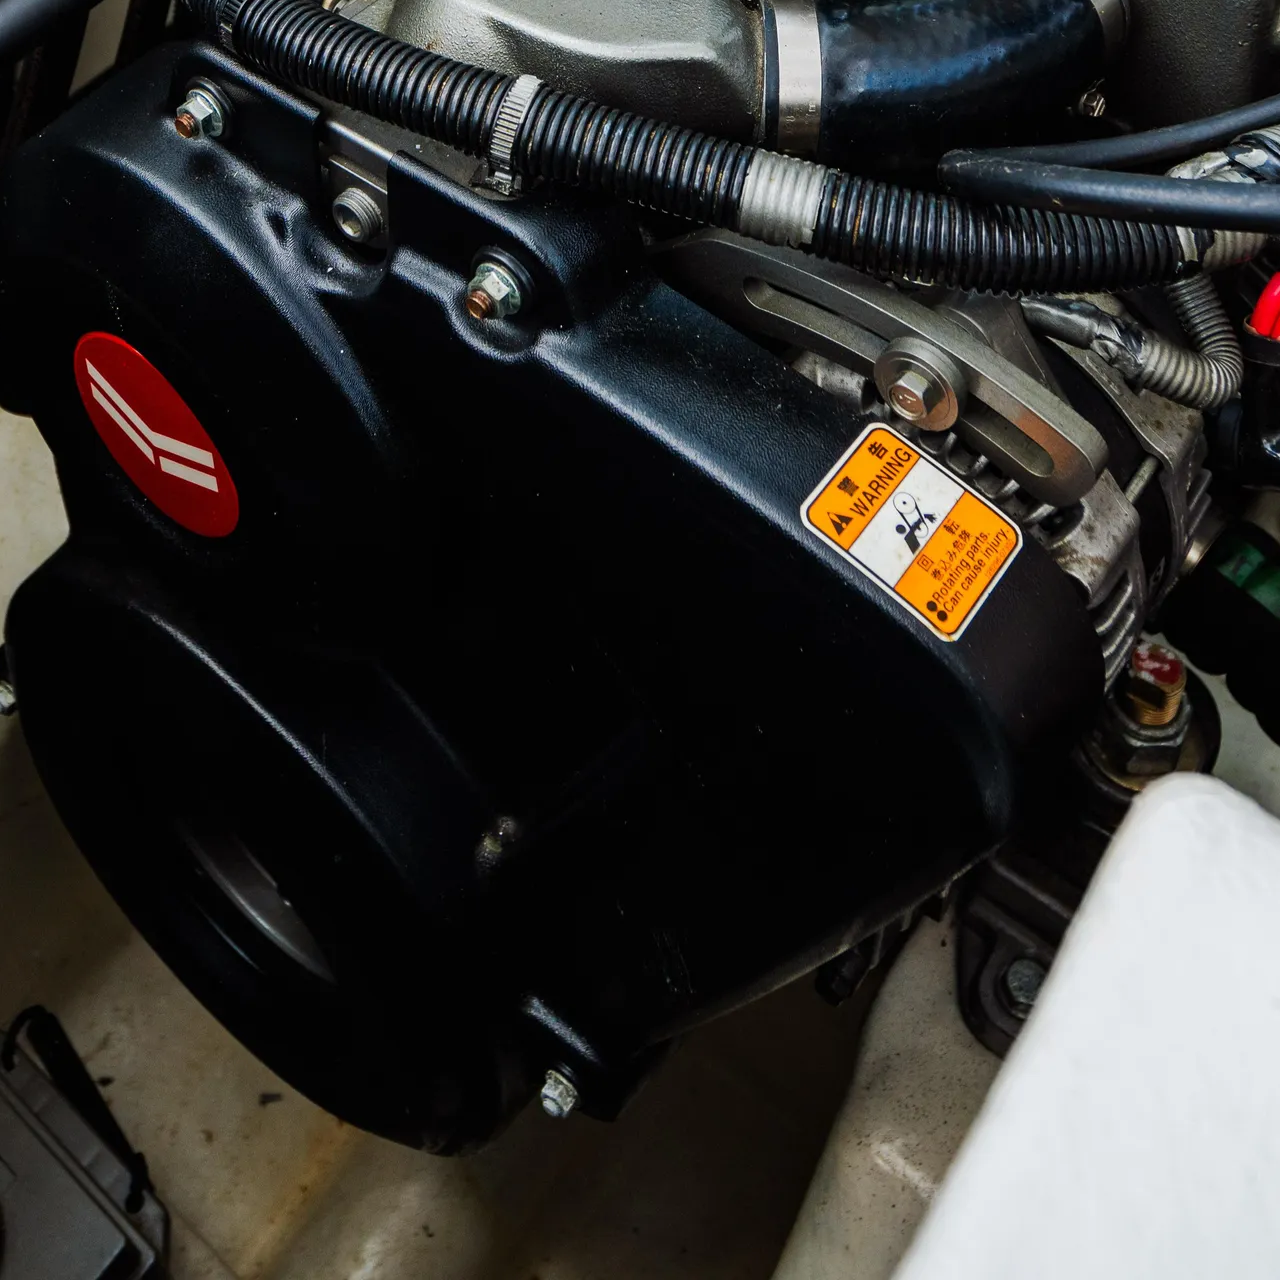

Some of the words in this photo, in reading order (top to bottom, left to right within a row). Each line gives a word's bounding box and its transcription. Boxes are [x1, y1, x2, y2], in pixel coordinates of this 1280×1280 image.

[849, 447, 914, 518] WARNING
[932, 558, 971, 605] Rotating
[966, 531, 991, 565] parts.
[943, 593, 964, 614] Can
[961, 559, 987, 593] cause
[983, 529, 1011, 563] injury.
